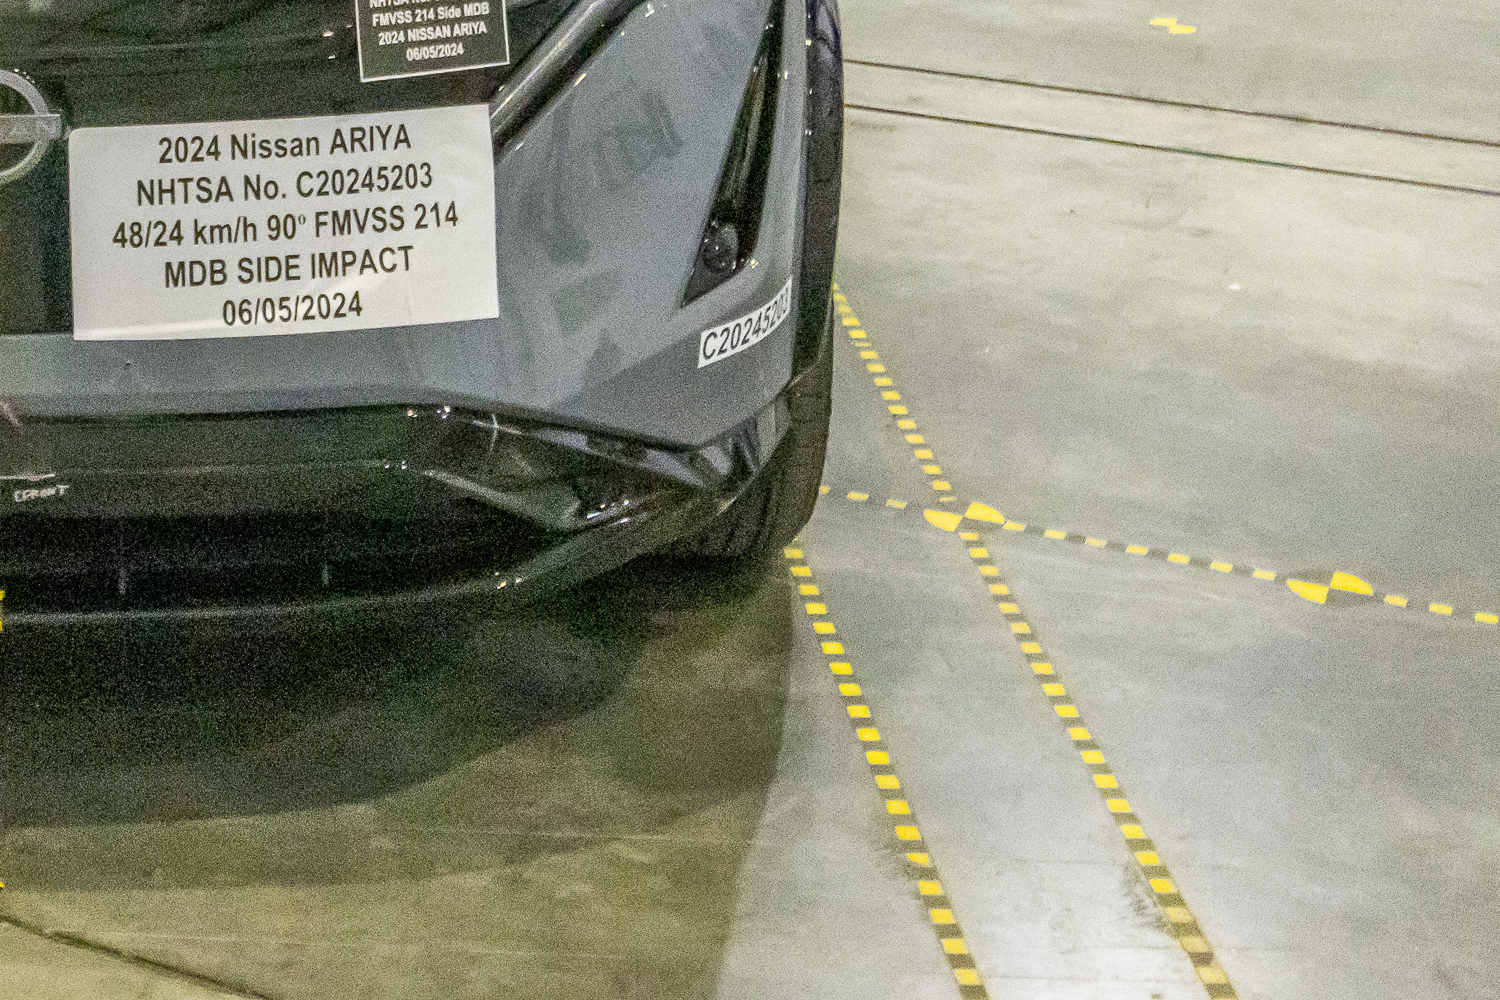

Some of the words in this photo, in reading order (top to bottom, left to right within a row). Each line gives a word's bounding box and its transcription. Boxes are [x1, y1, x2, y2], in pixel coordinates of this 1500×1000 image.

[373, 10, 412, 27] FMVSS
[415, 8, 435, 22] 214
[438, 6, 461, 19] Side
[464, 2, 489, 17] MDB
[379, 31, 405, 45] 2024
[408, 25, 450, 42] NISSAN
[453, 21, 487, 37] ARIYA
[407, 43, 465, 61] 06/05/2024
[159, 135, 221, 164] 2024
[231, 131, 320, 161] Nissan
[329, 124, 412, 155] ARIYA
[136, 176, 234, 207] NHTSA
[245, 172, 286, 201] No.
[297, 161, 433, 198] C20245203
[113, 219, 184, 248] 48/24
[194, 216, 258, 245] km/h
[315, 205, 406, 238] FMVSS
[414, 201, 459, 231] 214
[165, 259, 228, 288] MDB
[238, 254, 301, 285] SIDE
[311, 245, 414, 279] IMPACT
[223, 291, 363, 326] 06/05/2024
